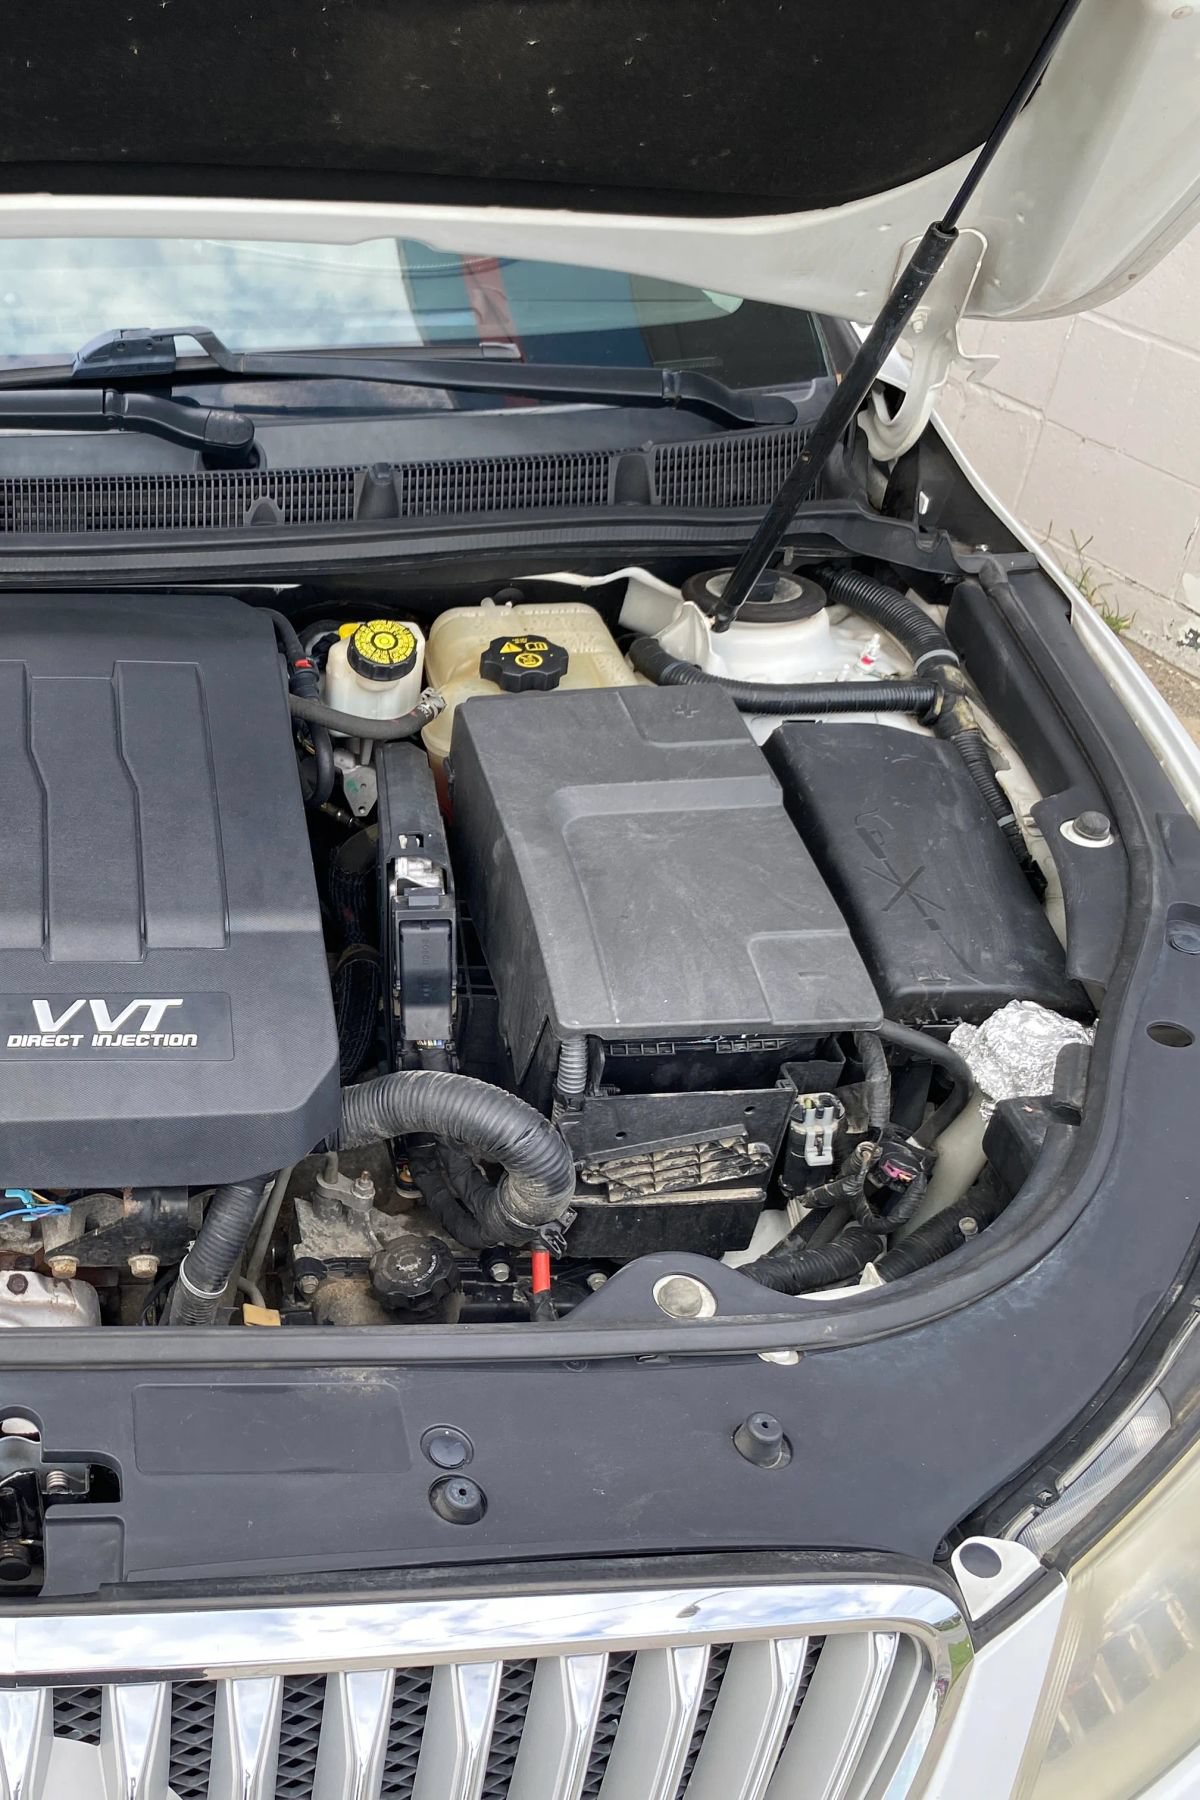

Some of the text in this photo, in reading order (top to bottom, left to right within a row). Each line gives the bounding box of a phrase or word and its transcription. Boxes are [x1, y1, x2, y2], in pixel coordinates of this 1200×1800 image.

[31, 998, 184, 1033] VVT
[6, 1033, 198, 1048] DIRECT INJECTION
